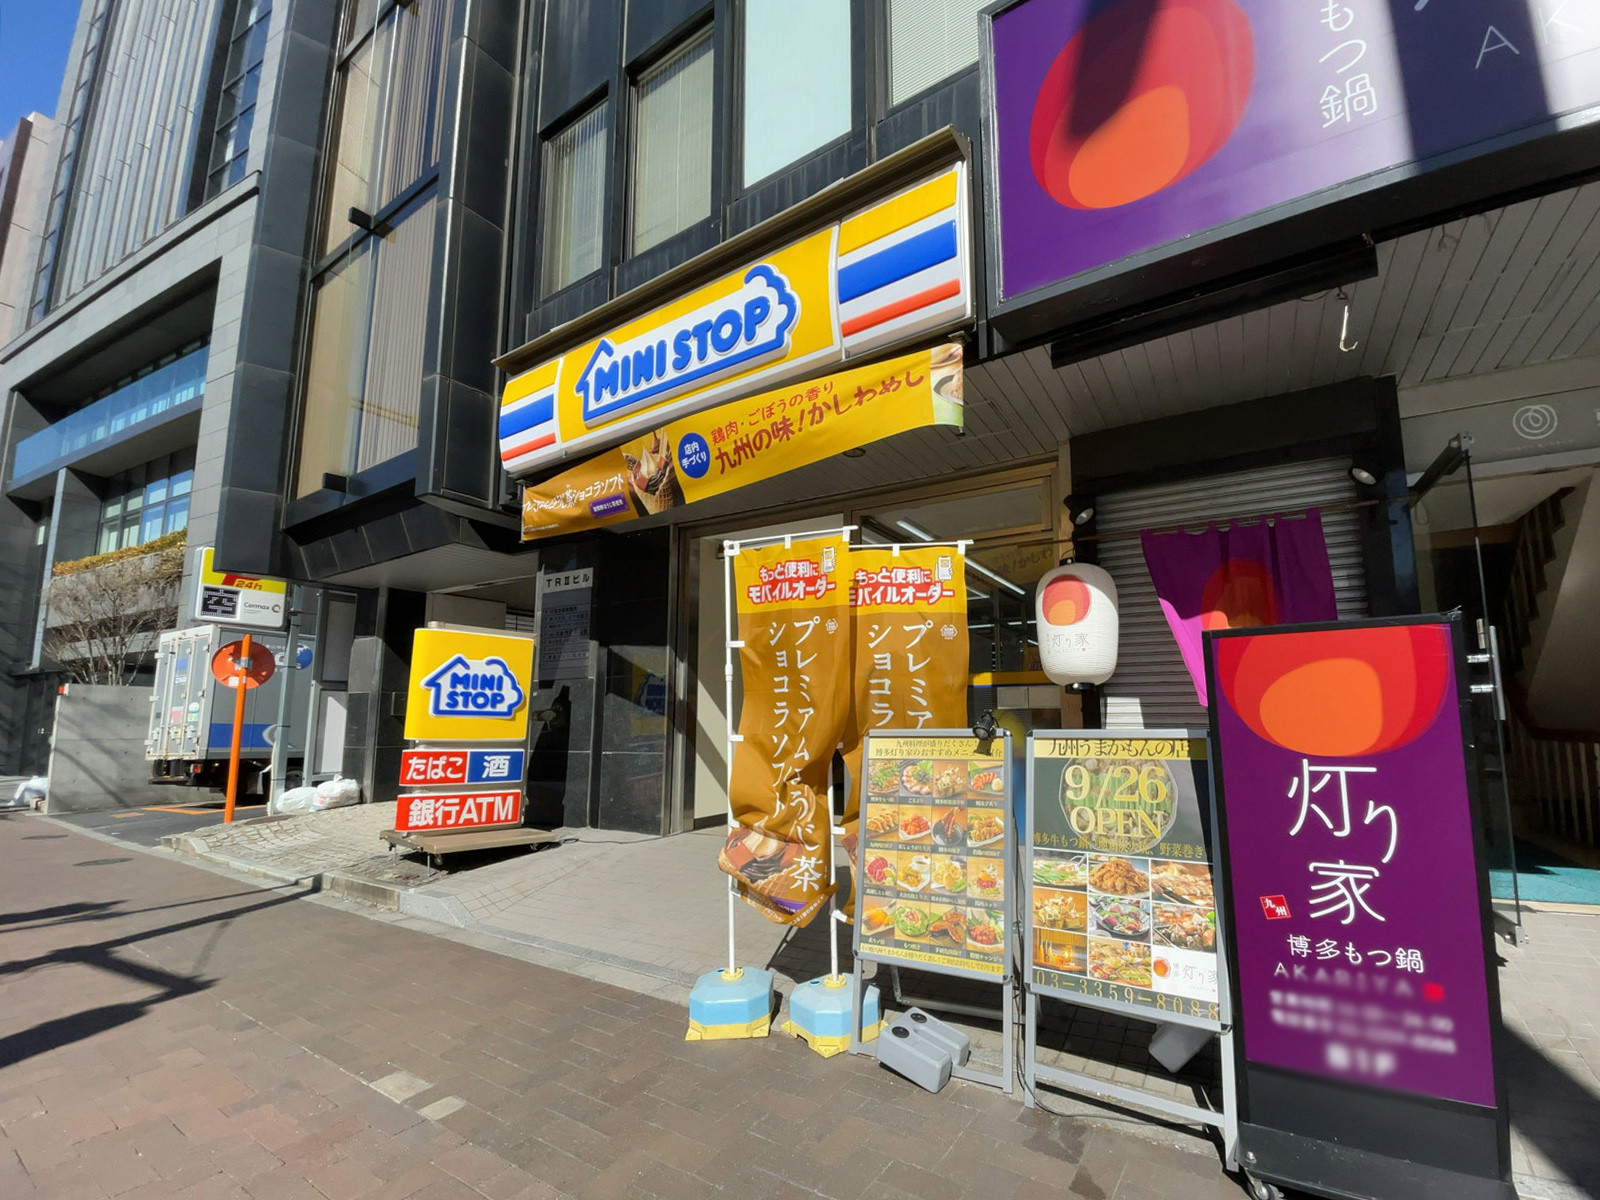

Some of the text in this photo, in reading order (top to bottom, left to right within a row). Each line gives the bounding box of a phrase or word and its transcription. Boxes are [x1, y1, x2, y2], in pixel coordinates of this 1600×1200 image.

[1319, 0, 1377, 128] もつ鍋
[684, 441, 700, 455] 店内
[681, 451, 707, 469] 手づくり
[760, 561, 818, 582] もっと便利に
[855, 568, 931, 585] もっと便利に
[235, 580, 262, 590] 24h
[748, 576, 836, 603] モバイルオーダー
[450, 672, 504, 690] MINI
[445, 692, 505, 709] STOP
[769, 621, 790, 818] ショコラソフト
[1049, 738, 1191, 758] 九州うまかもんの店
[406, 756, 463, 781] たばこ
[482, 755, 511, 778] 酒
[1065, 765, 1167, 808] 9/26
[408, 795, 514, 827] 銀行ATM
[1070, 806, 1164, 838] OPEN
[1264, 898, 1288, 917] 九州
[1287, 934, 1425, 973] 博多もつ鍋
